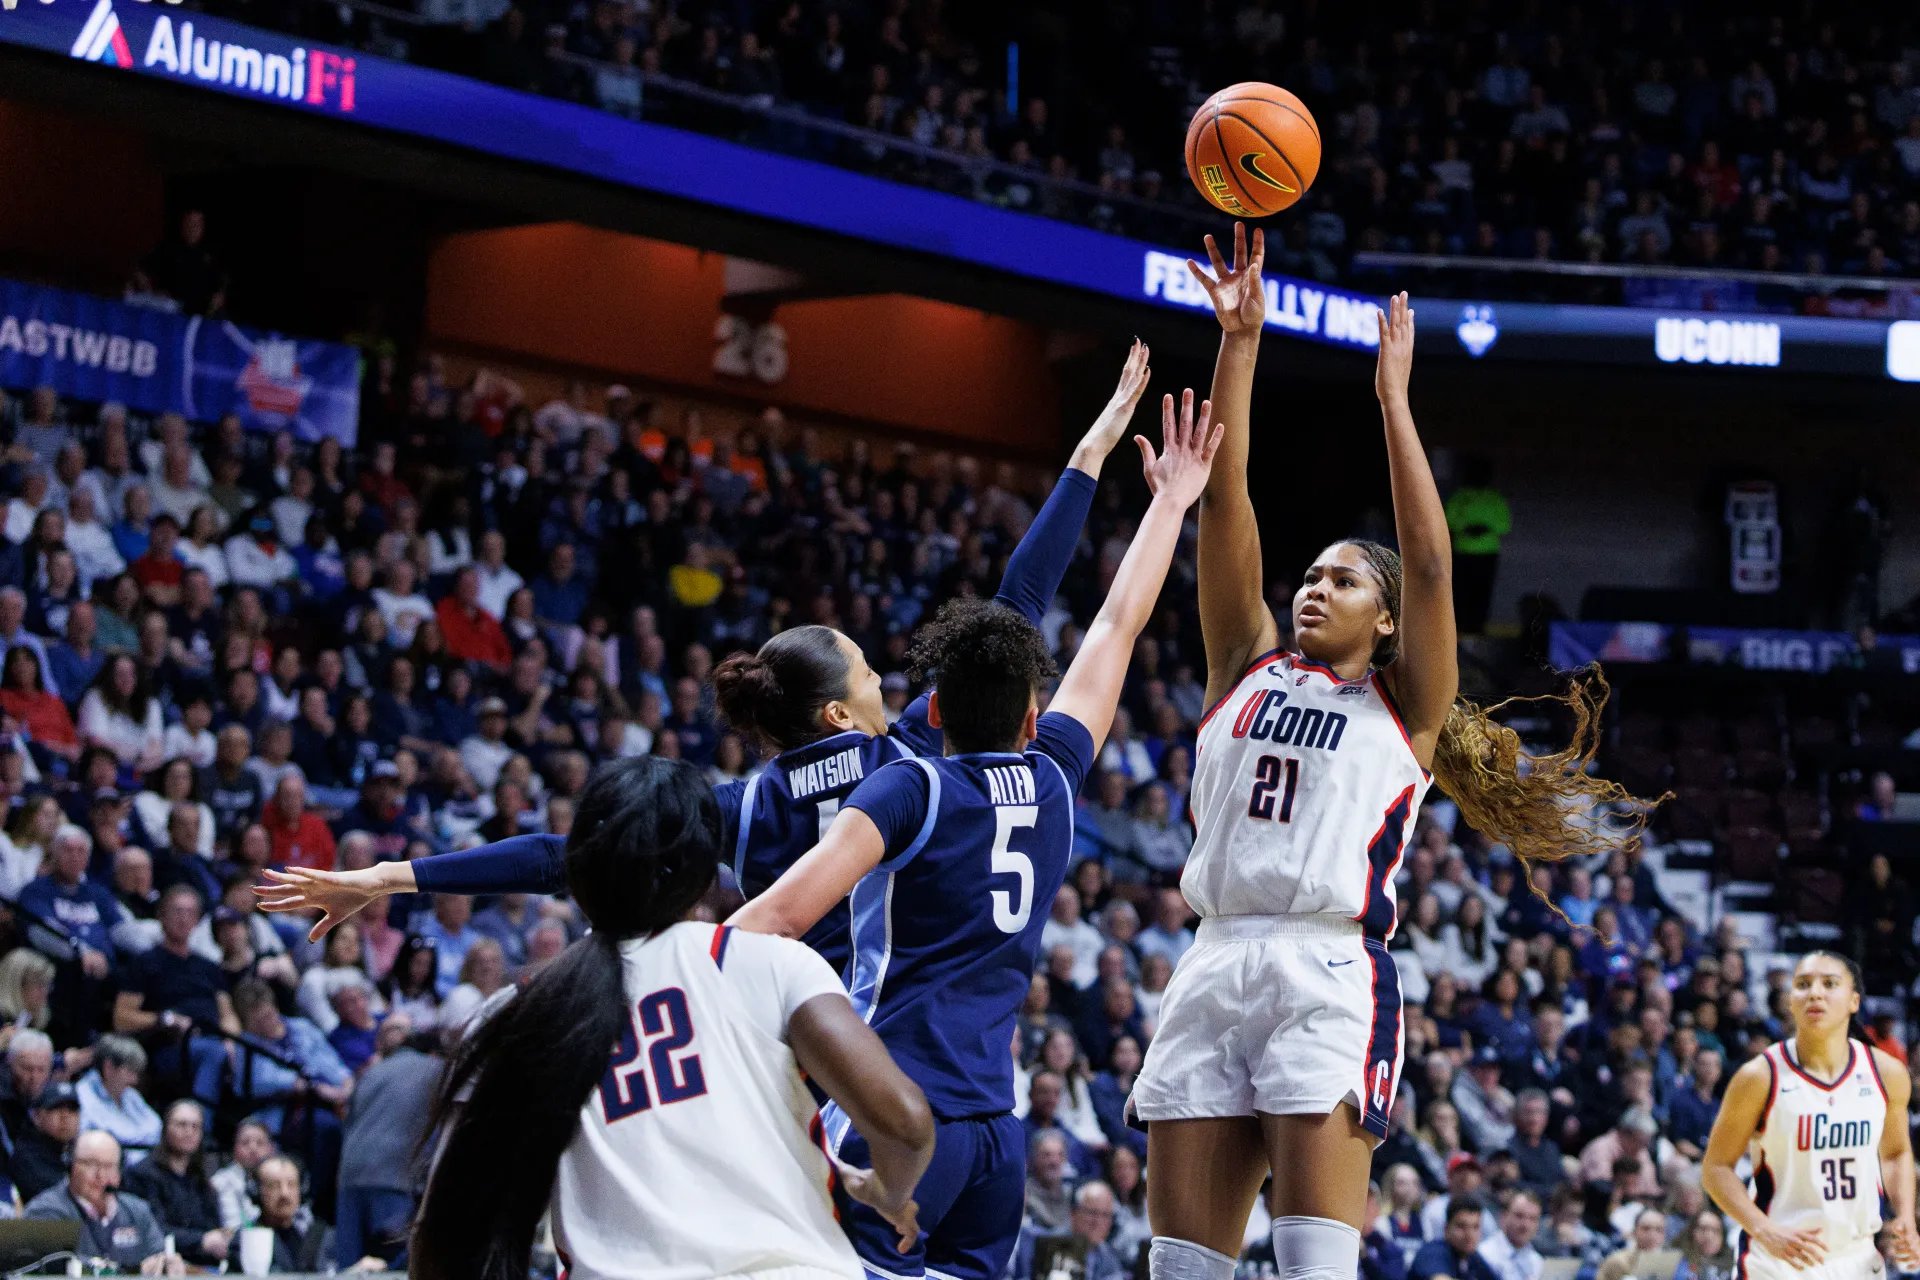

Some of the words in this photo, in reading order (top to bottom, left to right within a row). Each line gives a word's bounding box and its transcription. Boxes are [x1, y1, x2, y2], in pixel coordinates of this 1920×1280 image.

[144, 15, 357, 112] AlumniFi
[1203, 164, 1255, 216] ELITE
[1144, 250, 1325, 333] FEDLLY
[713, 315, 789, 382] 26
[1656, 318, 1780, 366] UCONN
[1232, 689, 1348, 751] UConn
[789, 746, 864, 799] WATSON
[983, 765, 1036, 804] ALLEN
[1248, 754, 1299, 823] 21
[990, 806, 1039, 933] 5
[600, 986, 708, 1125] 22
[1797, 1113, 1871, 1152] UConn
[1820, 1157, 1857, 1201] 35
